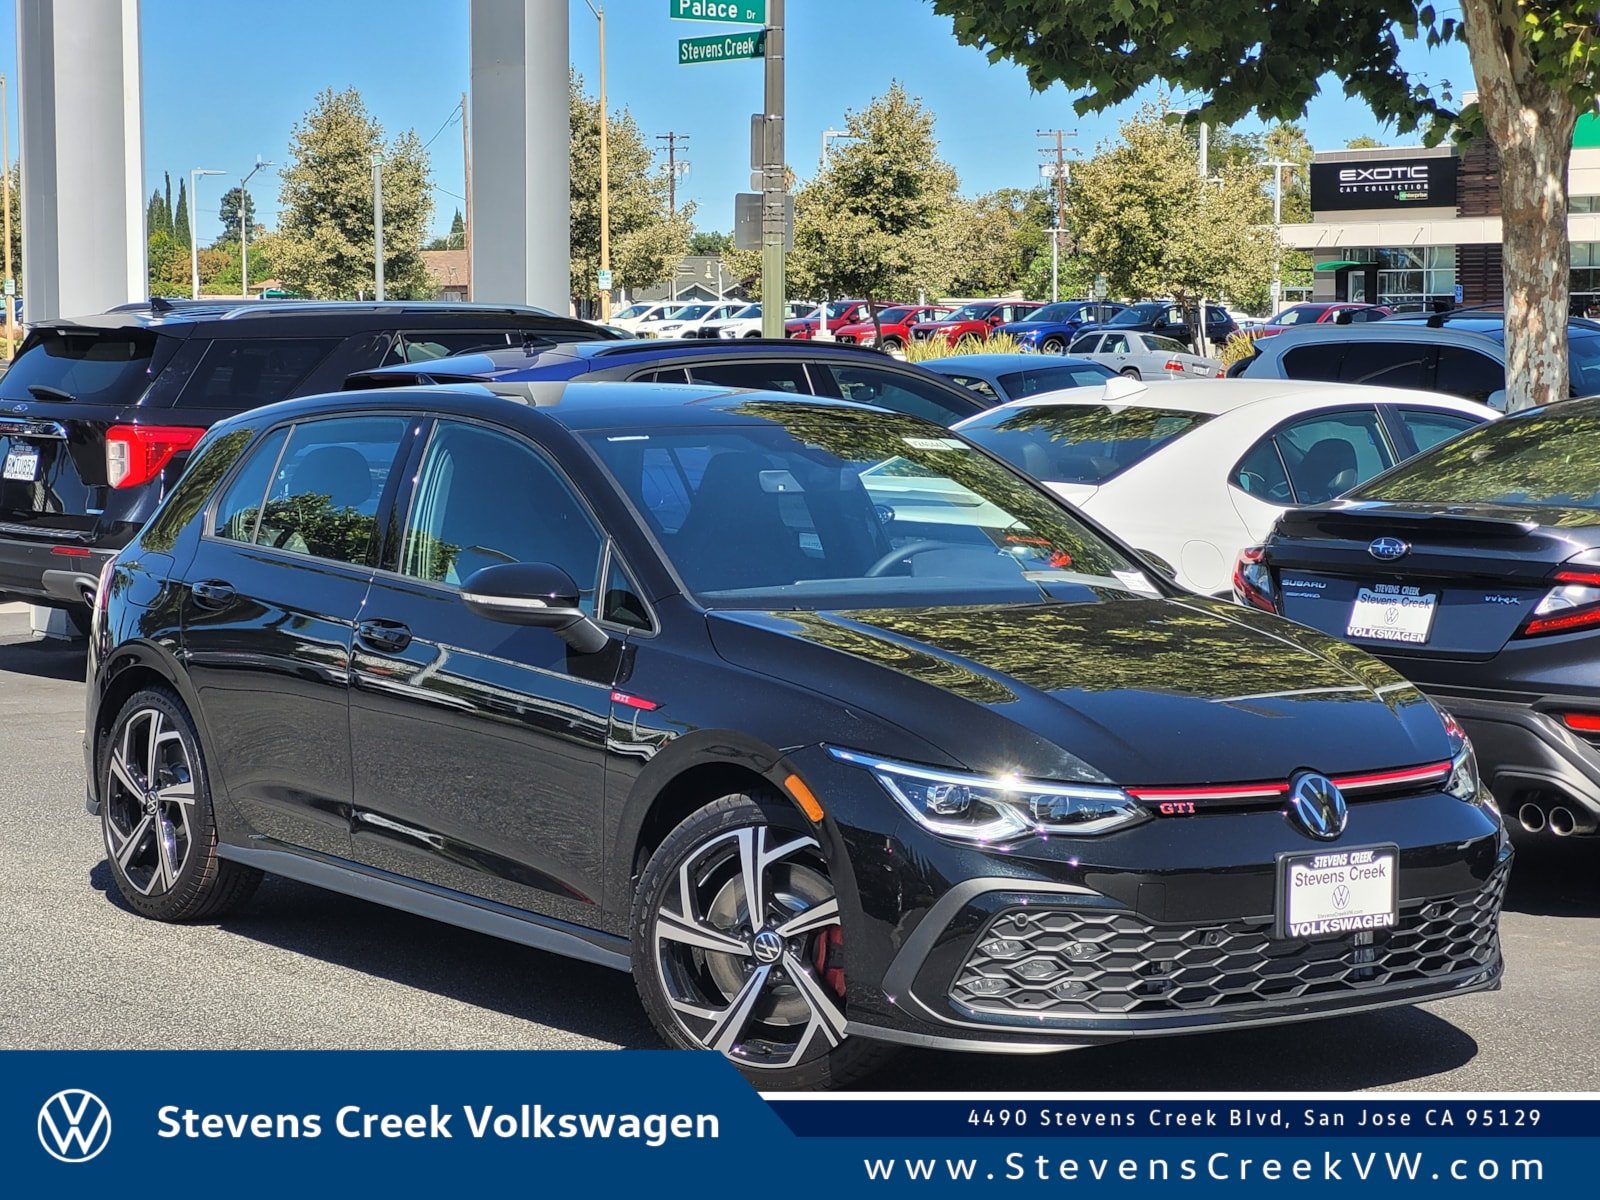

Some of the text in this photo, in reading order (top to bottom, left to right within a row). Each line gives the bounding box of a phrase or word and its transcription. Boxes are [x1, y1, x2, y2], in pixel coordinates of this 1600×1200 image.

[680, 0, 756, 20] Palace Dr
[681, 43, 722, 60] Stevens
[725, 37, 755, 56] Creek
[1339, 166, 1429, 181] EXOTIC
[1365, 183, 1429, 192] COLLECTION
[1282, 579, 1327, 588] SUBARU
[1374, 584, 1421, 596] STEVENS CREEK
[1360, 594, 1431, 609] Stevens Creek
[1347, 626, 1426, 643] VOLKSWAGEN
[1160, 802, 1195, 814] GTI
[1314, 851, 1374, 868] STEVENS CREEK
[1295, 864, 1386, 887] Stevens Creek
[1290, 912, 1395, 938] VOLKSWAGEN
